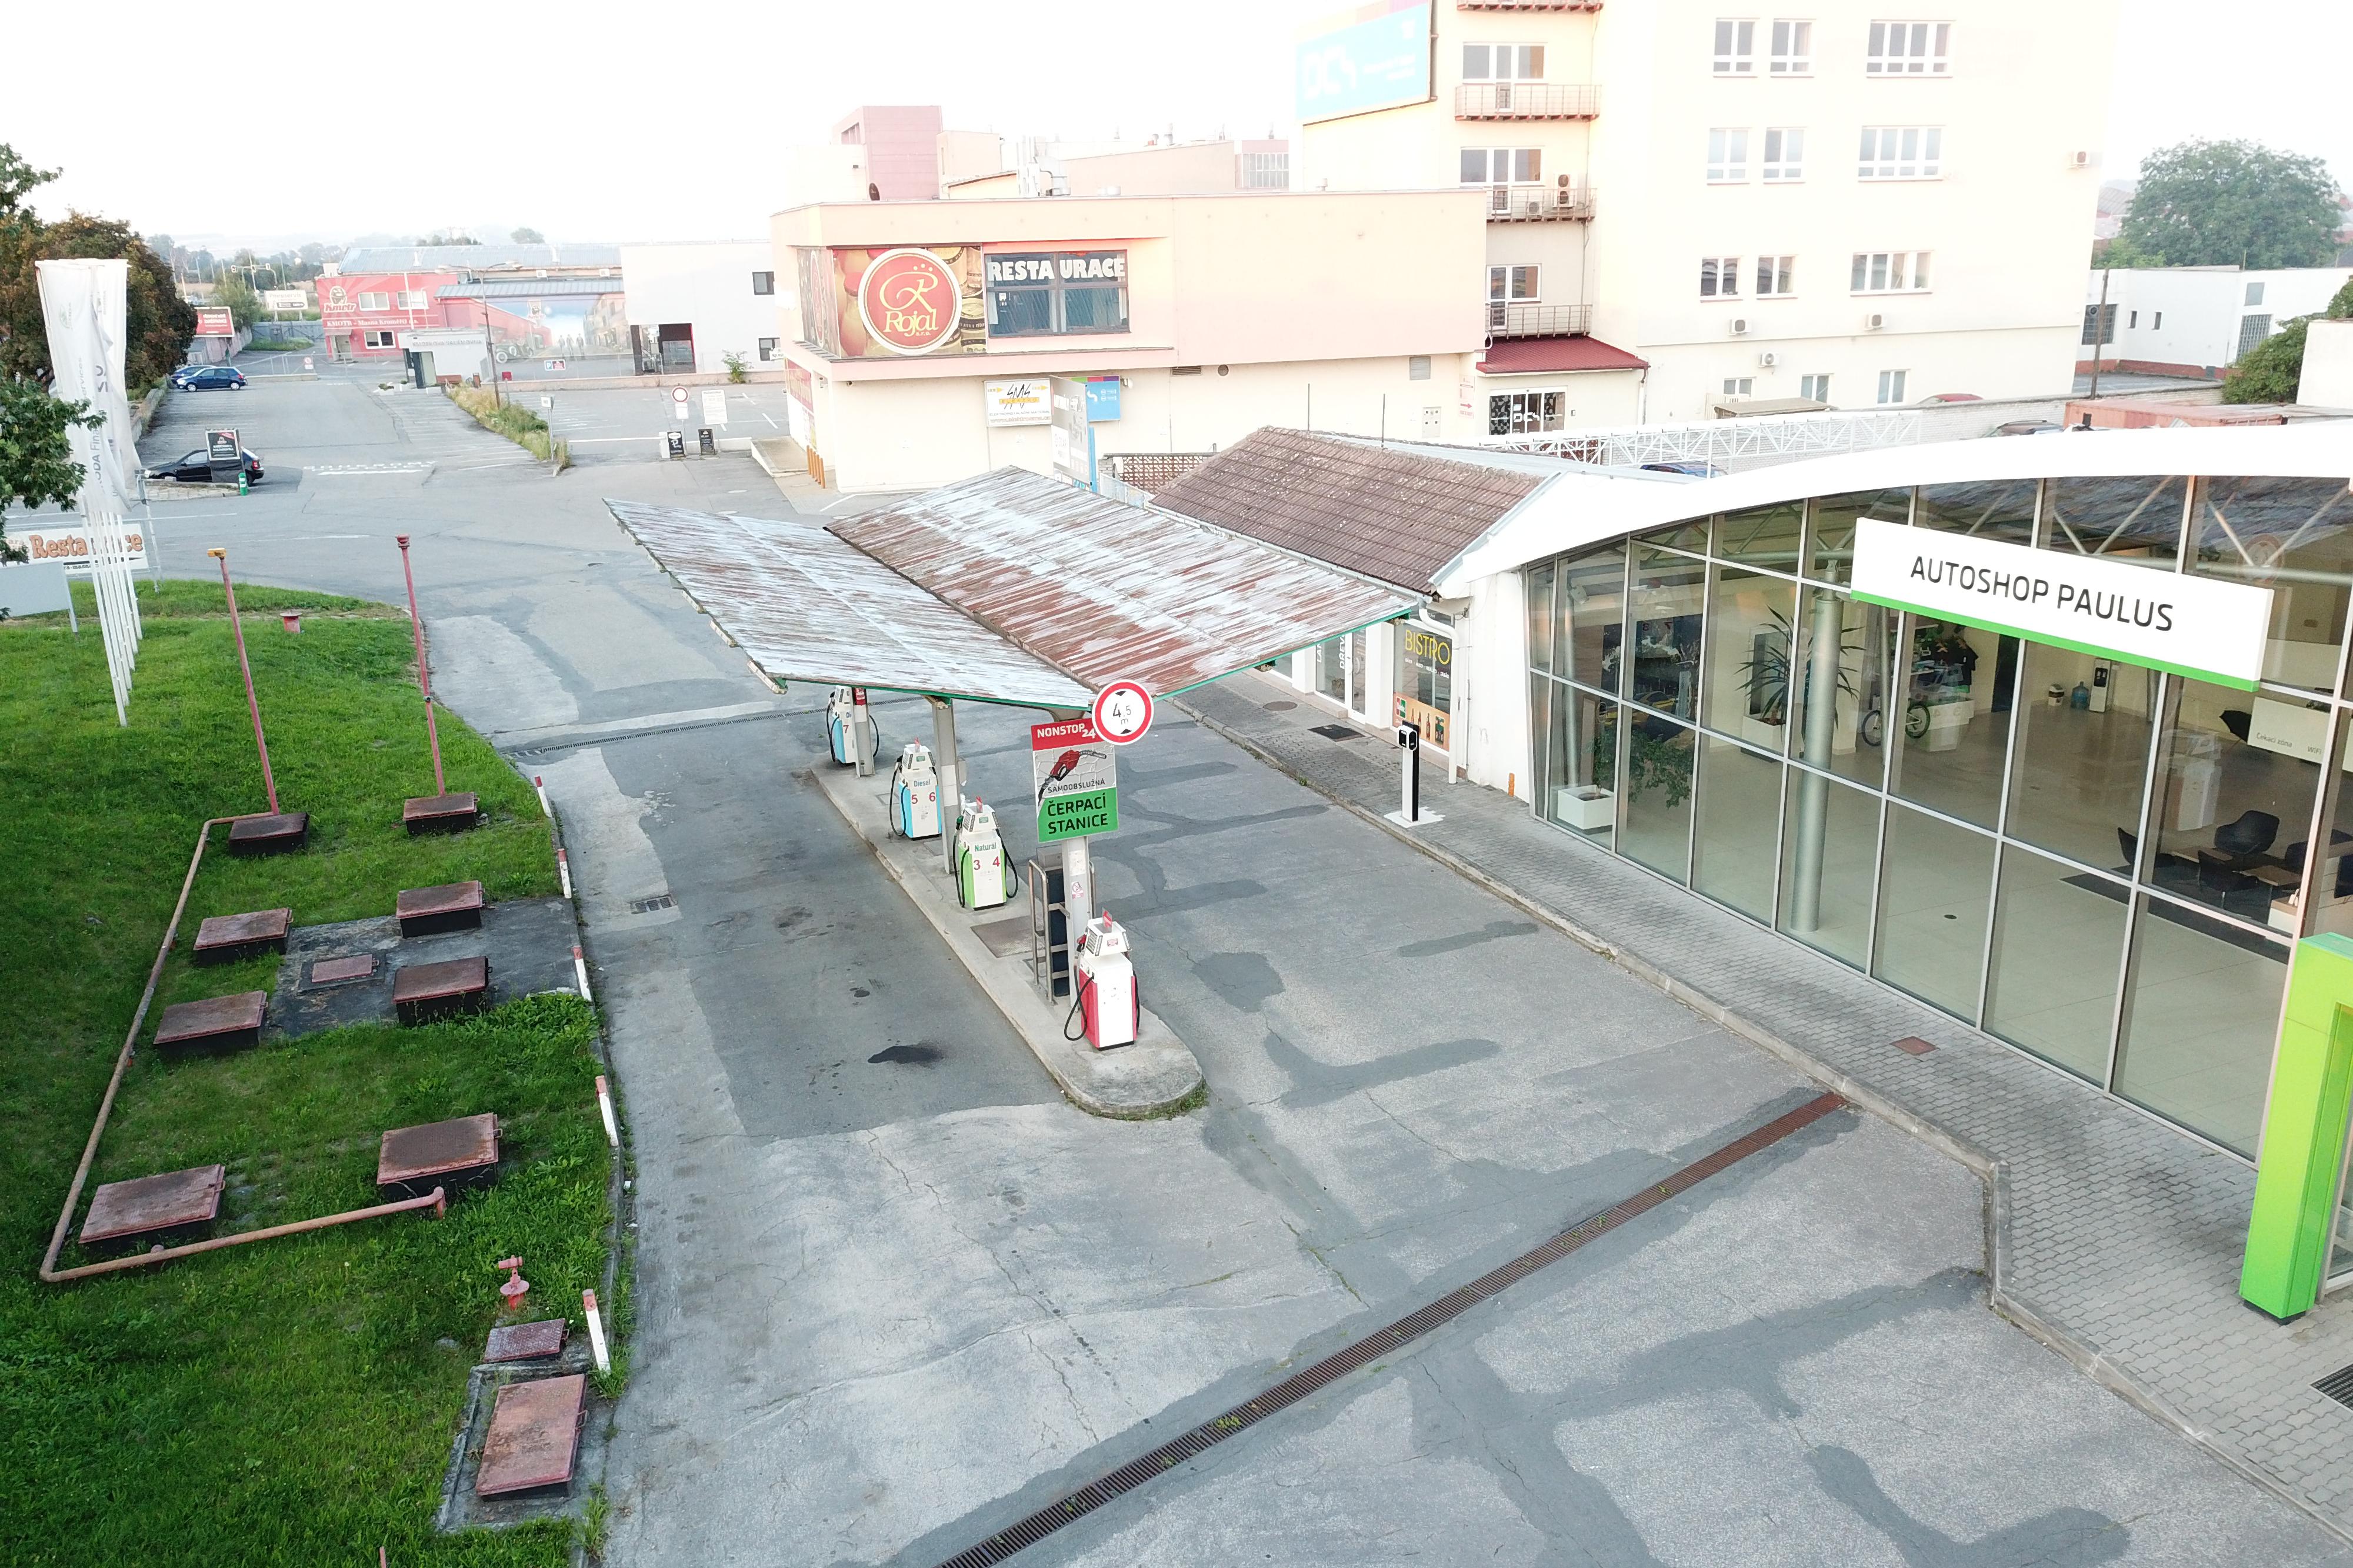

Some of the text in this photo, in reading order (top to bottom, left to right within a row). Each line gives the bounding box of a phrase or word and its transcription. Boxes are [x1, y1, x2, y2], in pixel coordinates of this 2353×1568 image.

[883, 309, 939, 337] Rojal
[1911, 556, 2174, 632] AUTOSHOP PAULUS
[1405, 629, 1450, 665] BISTRO
[843, 725, 849, 733] 7
[1037, 723, 1096, 739] NONSTOP 24
[2308, 746, 2322, 755] WiFi
[914, 779, 931, 787] Diesel
[1048, 778, 1105, 793] SAMOOBSLUŽNÁ
[911, 792, 936, 805] 5 6
[1048, 792, 1106, 816] ČERPACÍ
[1048, 813, 1108, 835] STANICE
[973, 856, 1000, 870] 3 4
